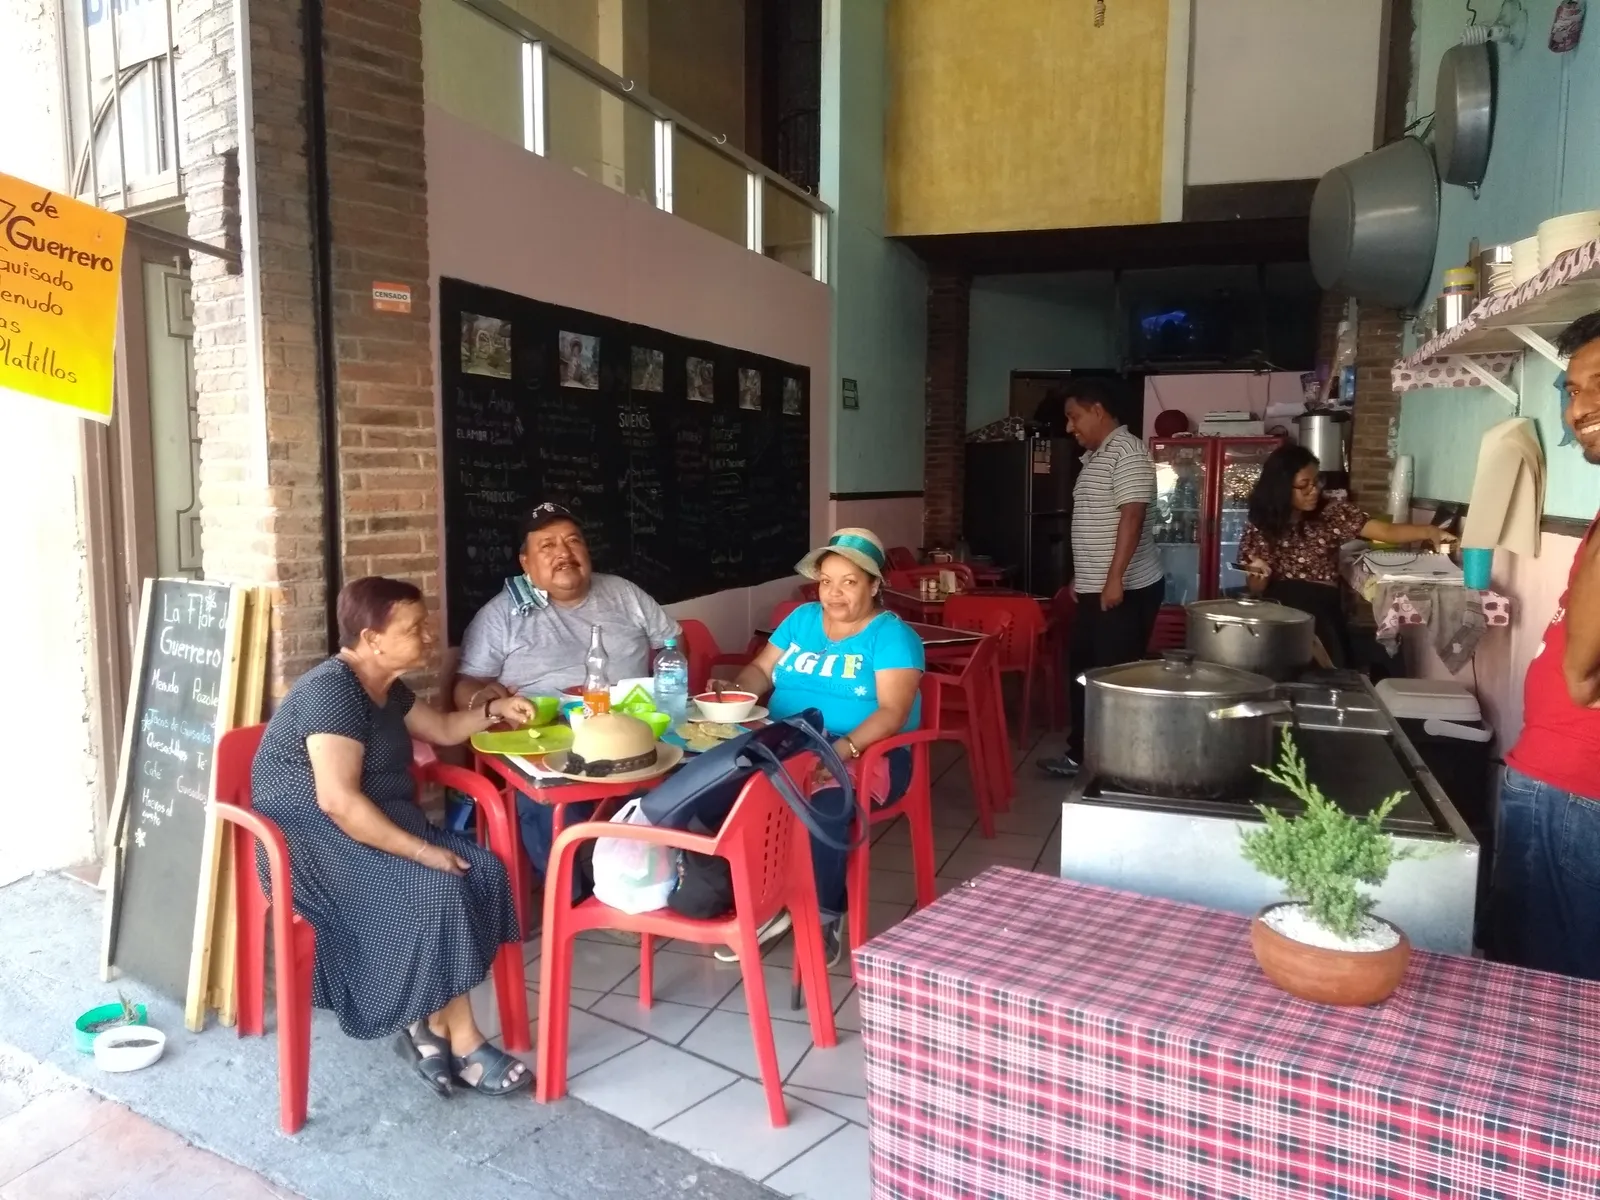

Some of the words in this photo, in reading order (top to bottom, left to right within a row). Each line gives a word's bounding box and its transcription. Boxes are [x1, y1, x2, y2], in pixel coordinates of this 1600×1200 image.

[31, 191, 60, 219] de
[6, 215, 114, 272] Guerrero
[0, 290, 64, 317] enudo
[374, 290, 408, 301] CENSADO
[0, 317, 21, 334] as
[163, 593, 181, 624] La
[187, 592, 216, 630] Flor
[218, 602, 229, 630] d
[160, 626, 221, 668] Guerrero
[151, 668, 180, 694] Menudo
[192, 677, 220, 707] Pozole
[143, 760, 163, 780] Café
